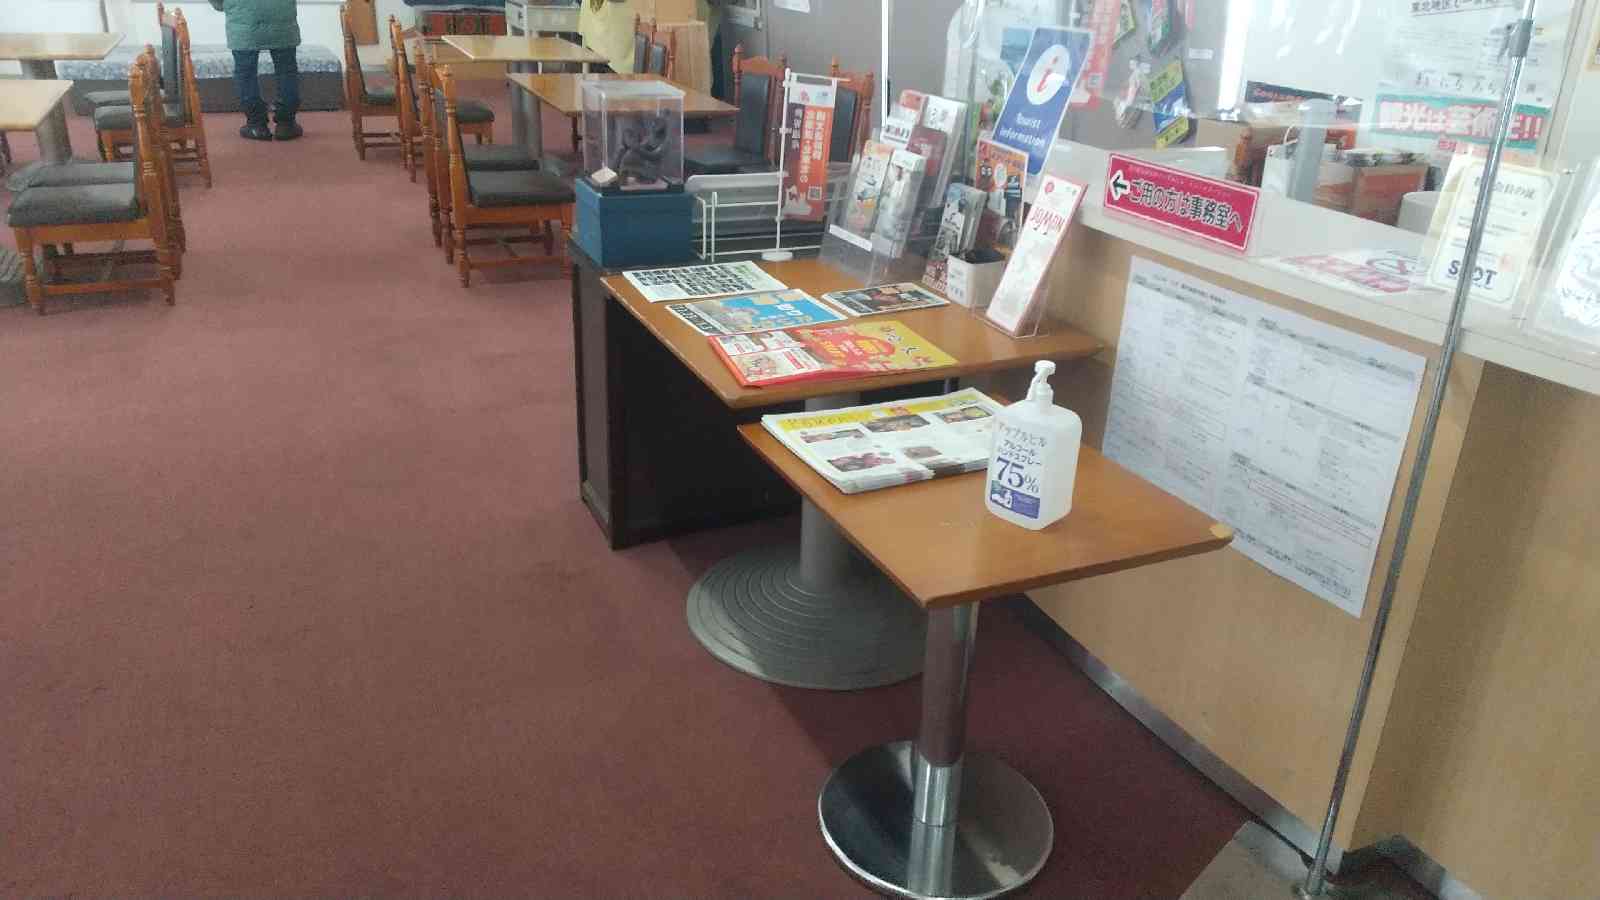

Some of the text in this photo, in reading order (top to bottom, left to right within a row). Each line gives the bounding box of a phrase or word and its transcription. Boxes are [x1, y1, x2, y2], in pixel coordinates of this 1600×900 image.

[1128, 178, 1243, 233] ご用の方は事務室へ
[996, 455, 1041, 493] 75%
